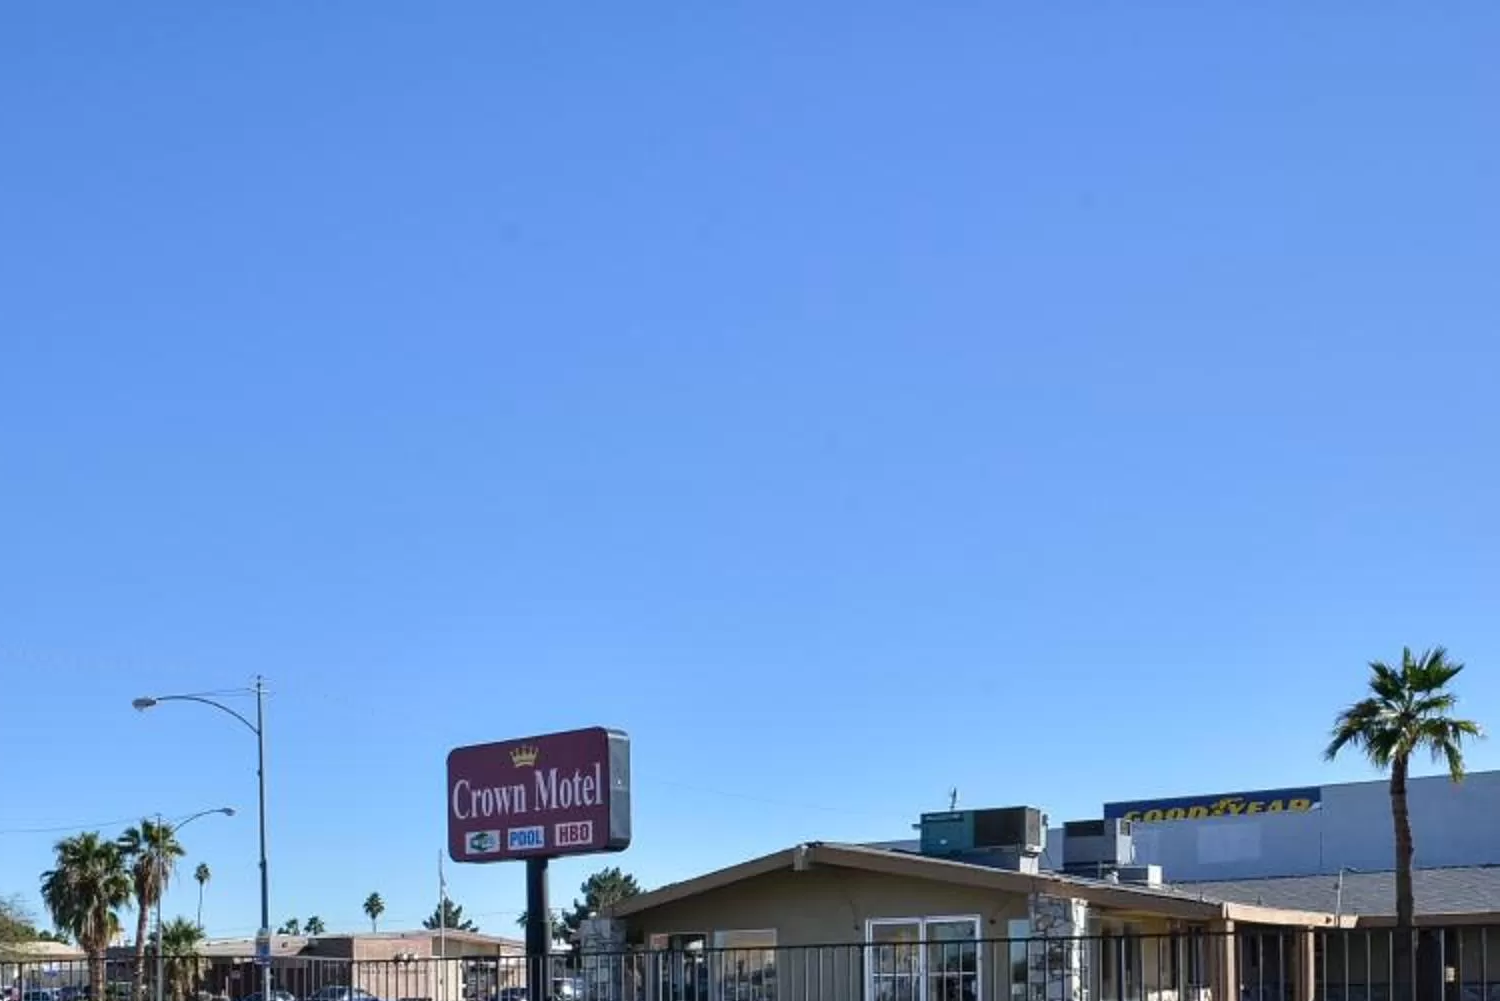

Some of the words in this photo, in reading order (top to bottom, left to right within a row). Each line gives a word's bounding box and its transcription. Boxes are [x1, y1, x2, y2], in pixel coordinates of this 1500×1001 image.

[453, 779, 527, 820] Crown
[534, 762, 604, 811] Motel
[1123, 797, 1311, 823] GOODYEAR
[510, 830, 542, 846] POOL
[559, 823, 589, 843] HBO
